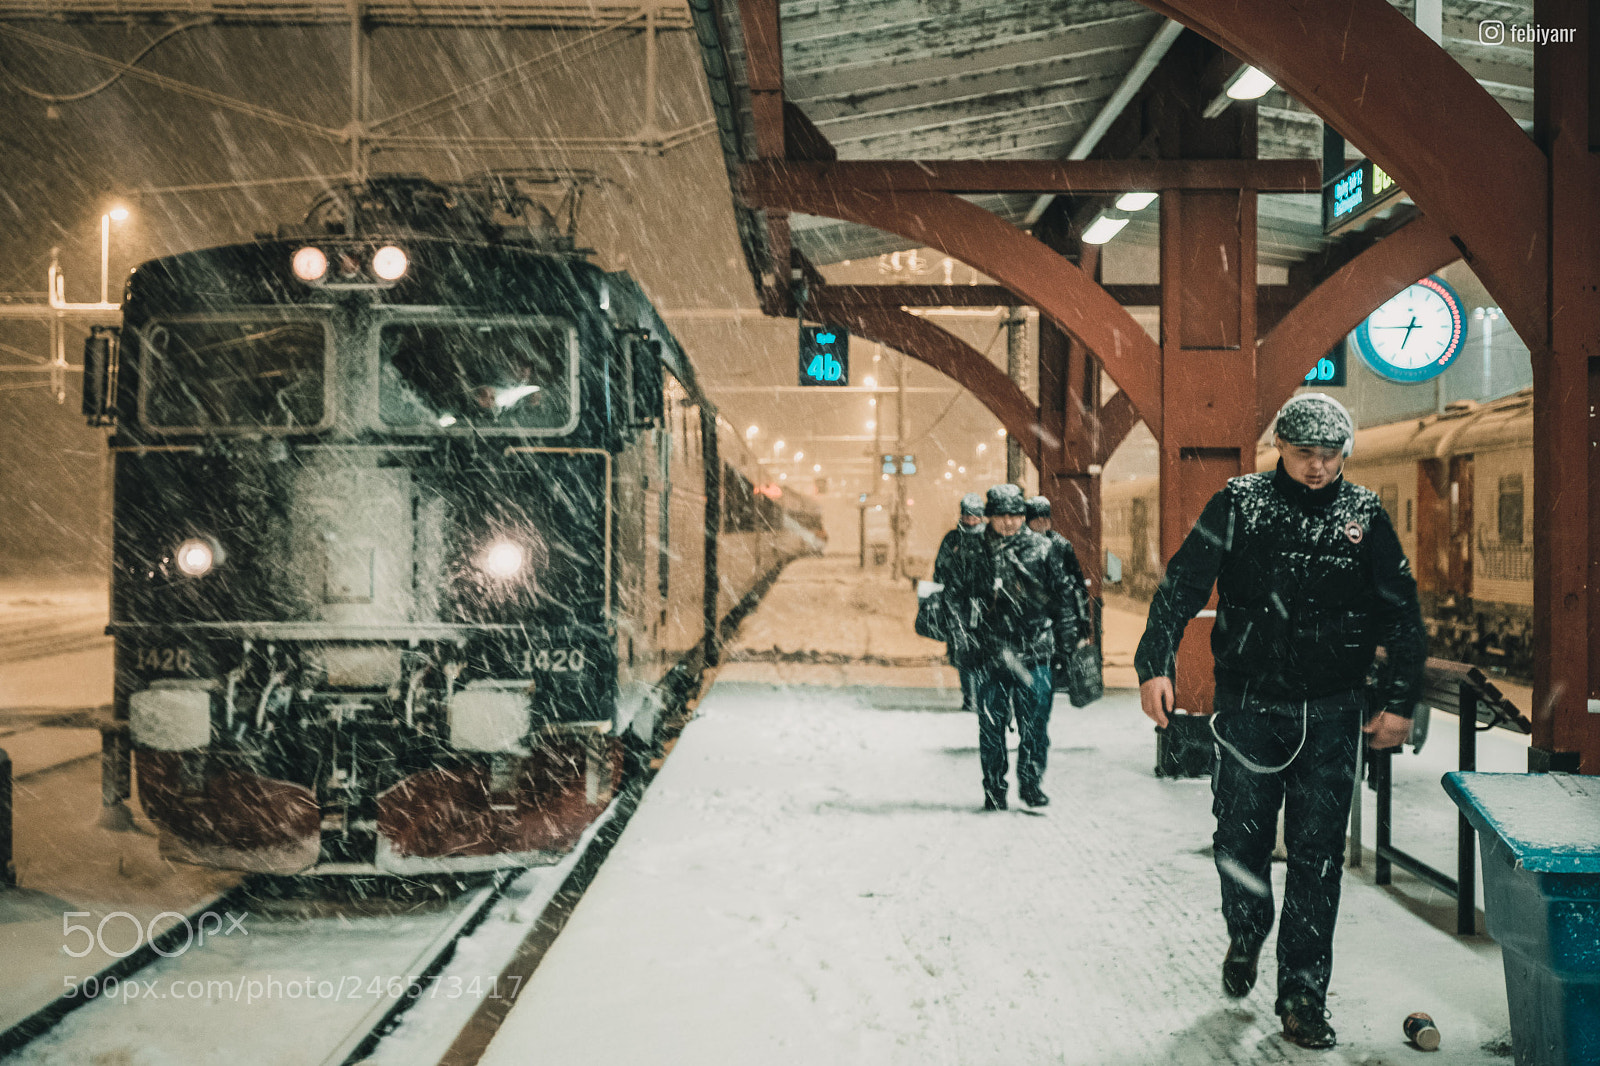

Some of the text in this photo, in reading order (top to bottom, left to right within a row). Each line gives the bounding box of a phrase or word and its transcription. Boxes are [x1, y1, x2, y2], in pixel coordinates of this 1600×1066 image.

[807, 353, 842, 381] 4b
[135, 647, 191, 671] 1420
[522, 649, 585, 672] 1420
